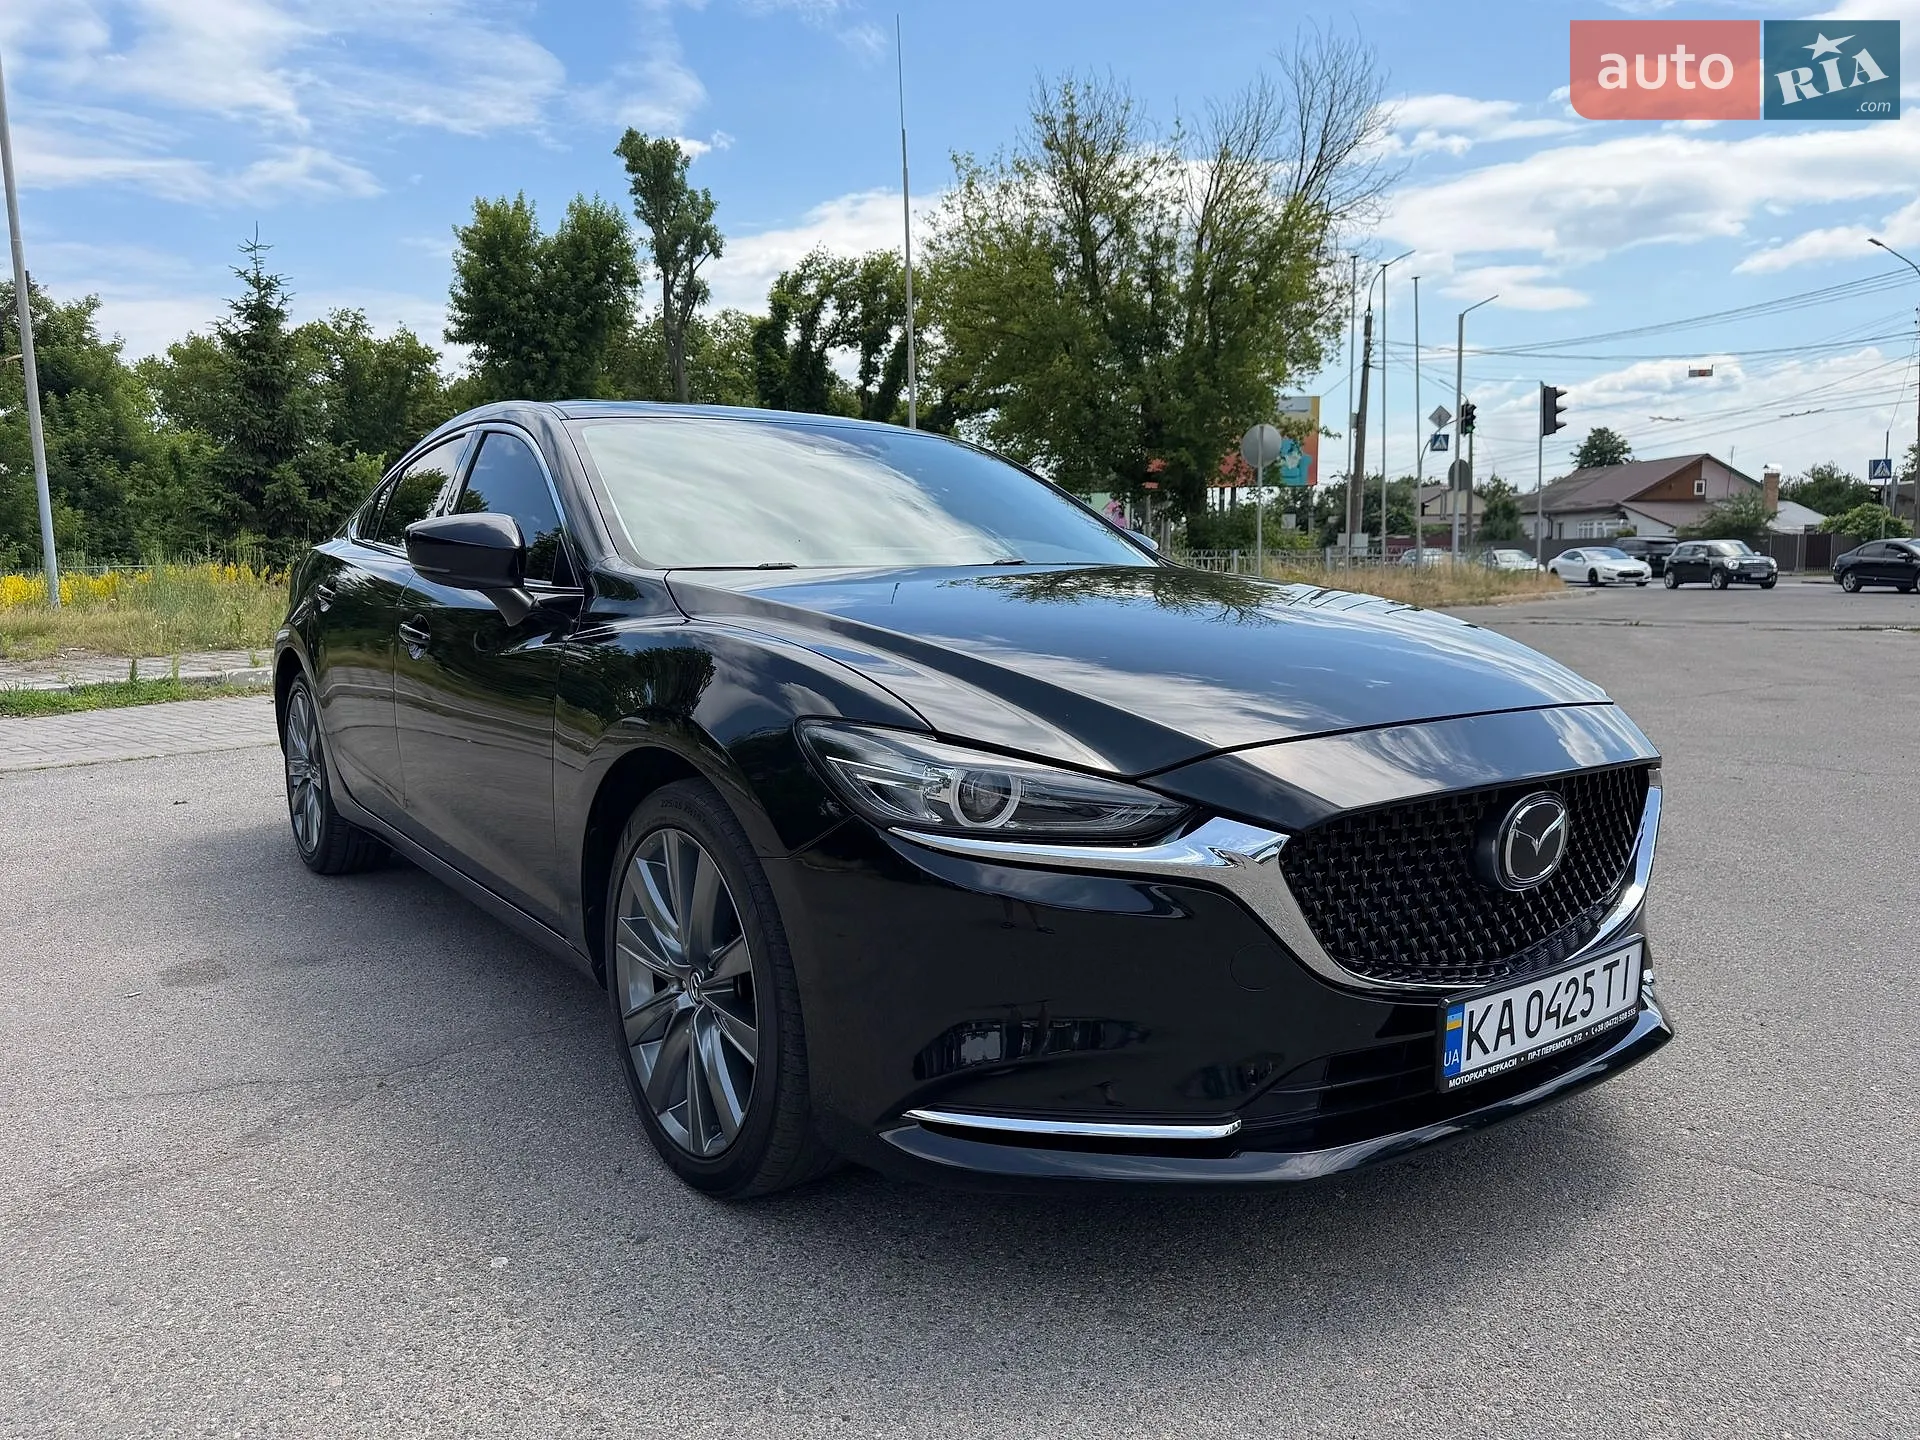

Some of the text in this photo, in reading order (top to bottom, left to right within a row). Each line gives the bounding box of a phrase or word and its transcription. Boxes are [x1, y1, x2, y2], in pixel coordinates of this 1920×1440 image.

[1466, 954, 1630, 1061] KA 0425 TI
[1444, 1049, 1459, 1067] UA
[1449, 1069, 1487, 1088] МОТОРКАР
[1488, 1058, 1517, 1074] ЧЕРКАСИ
